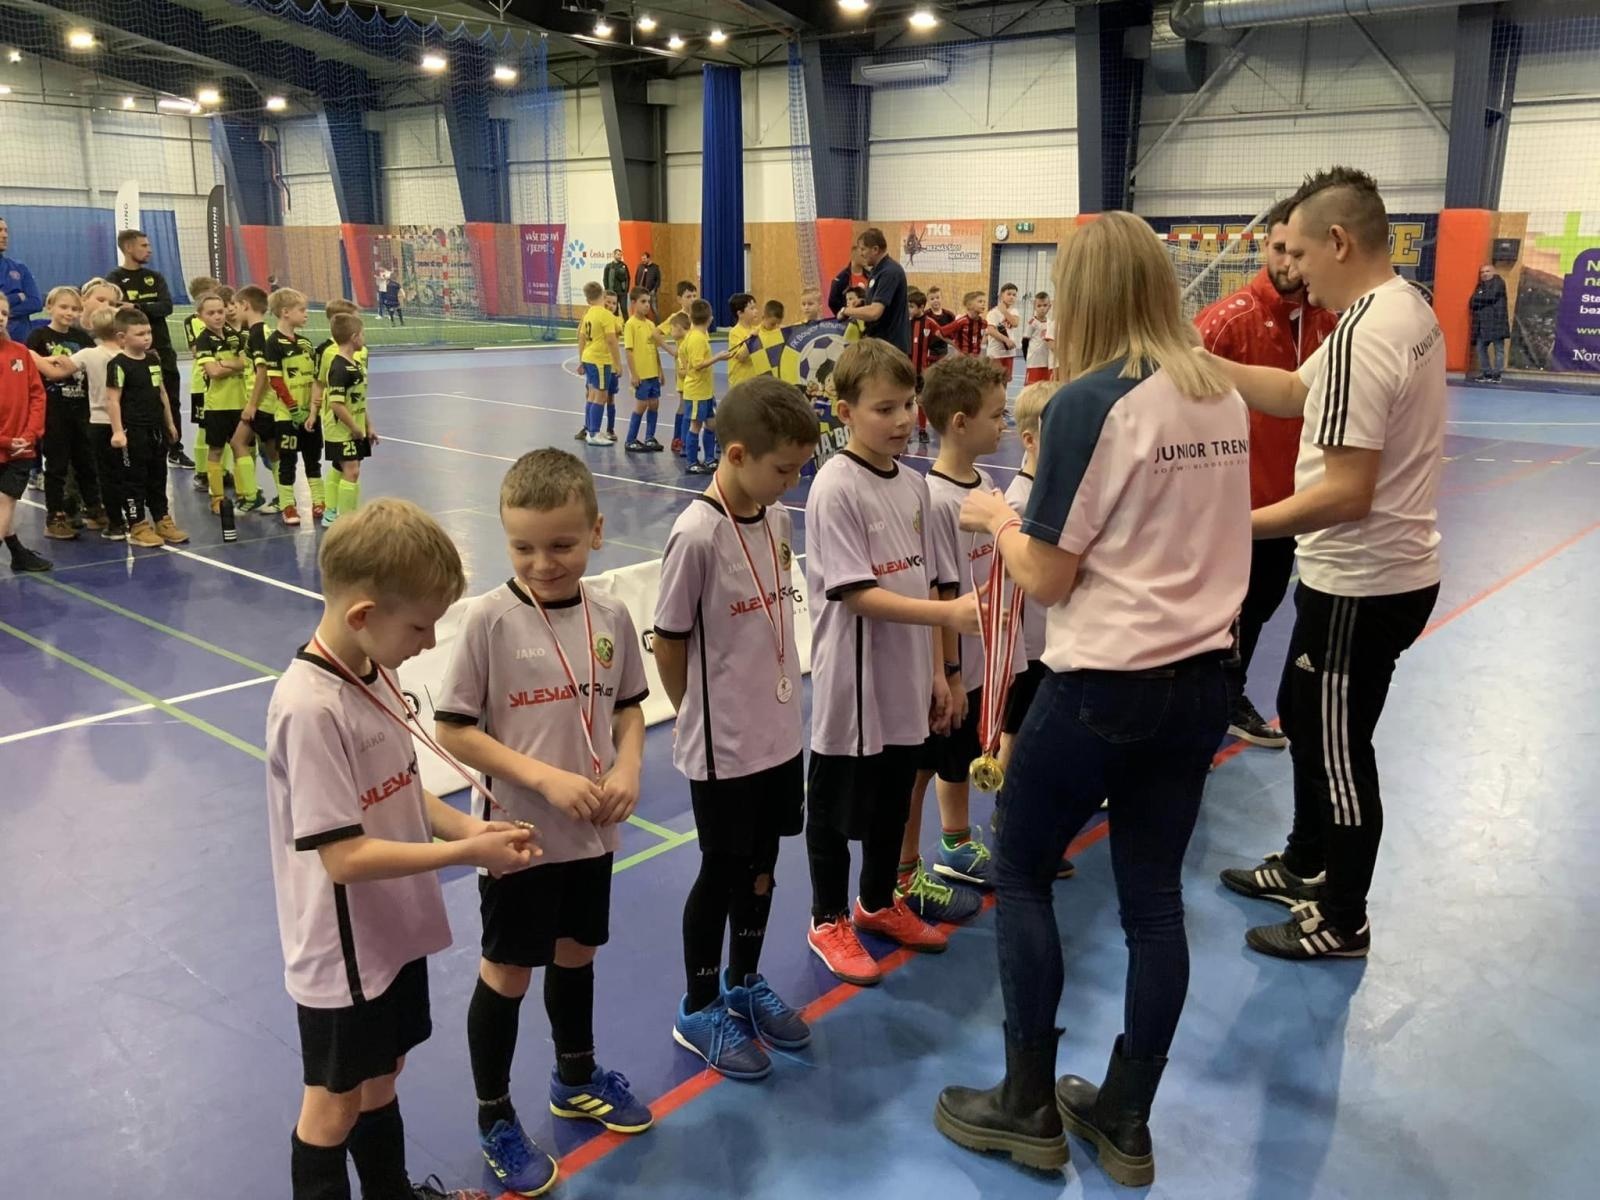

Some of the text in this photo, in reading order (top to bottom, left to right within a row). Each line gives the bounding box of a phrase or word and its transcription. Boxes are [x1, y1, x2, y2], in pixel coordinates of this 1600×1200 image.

[926, 223, 951, 236] TKR
[280, 434, 298, 450] 20
[1154, 442, 1206, 464] JUNIOR
[516, 647, 546, 660] JAKO
